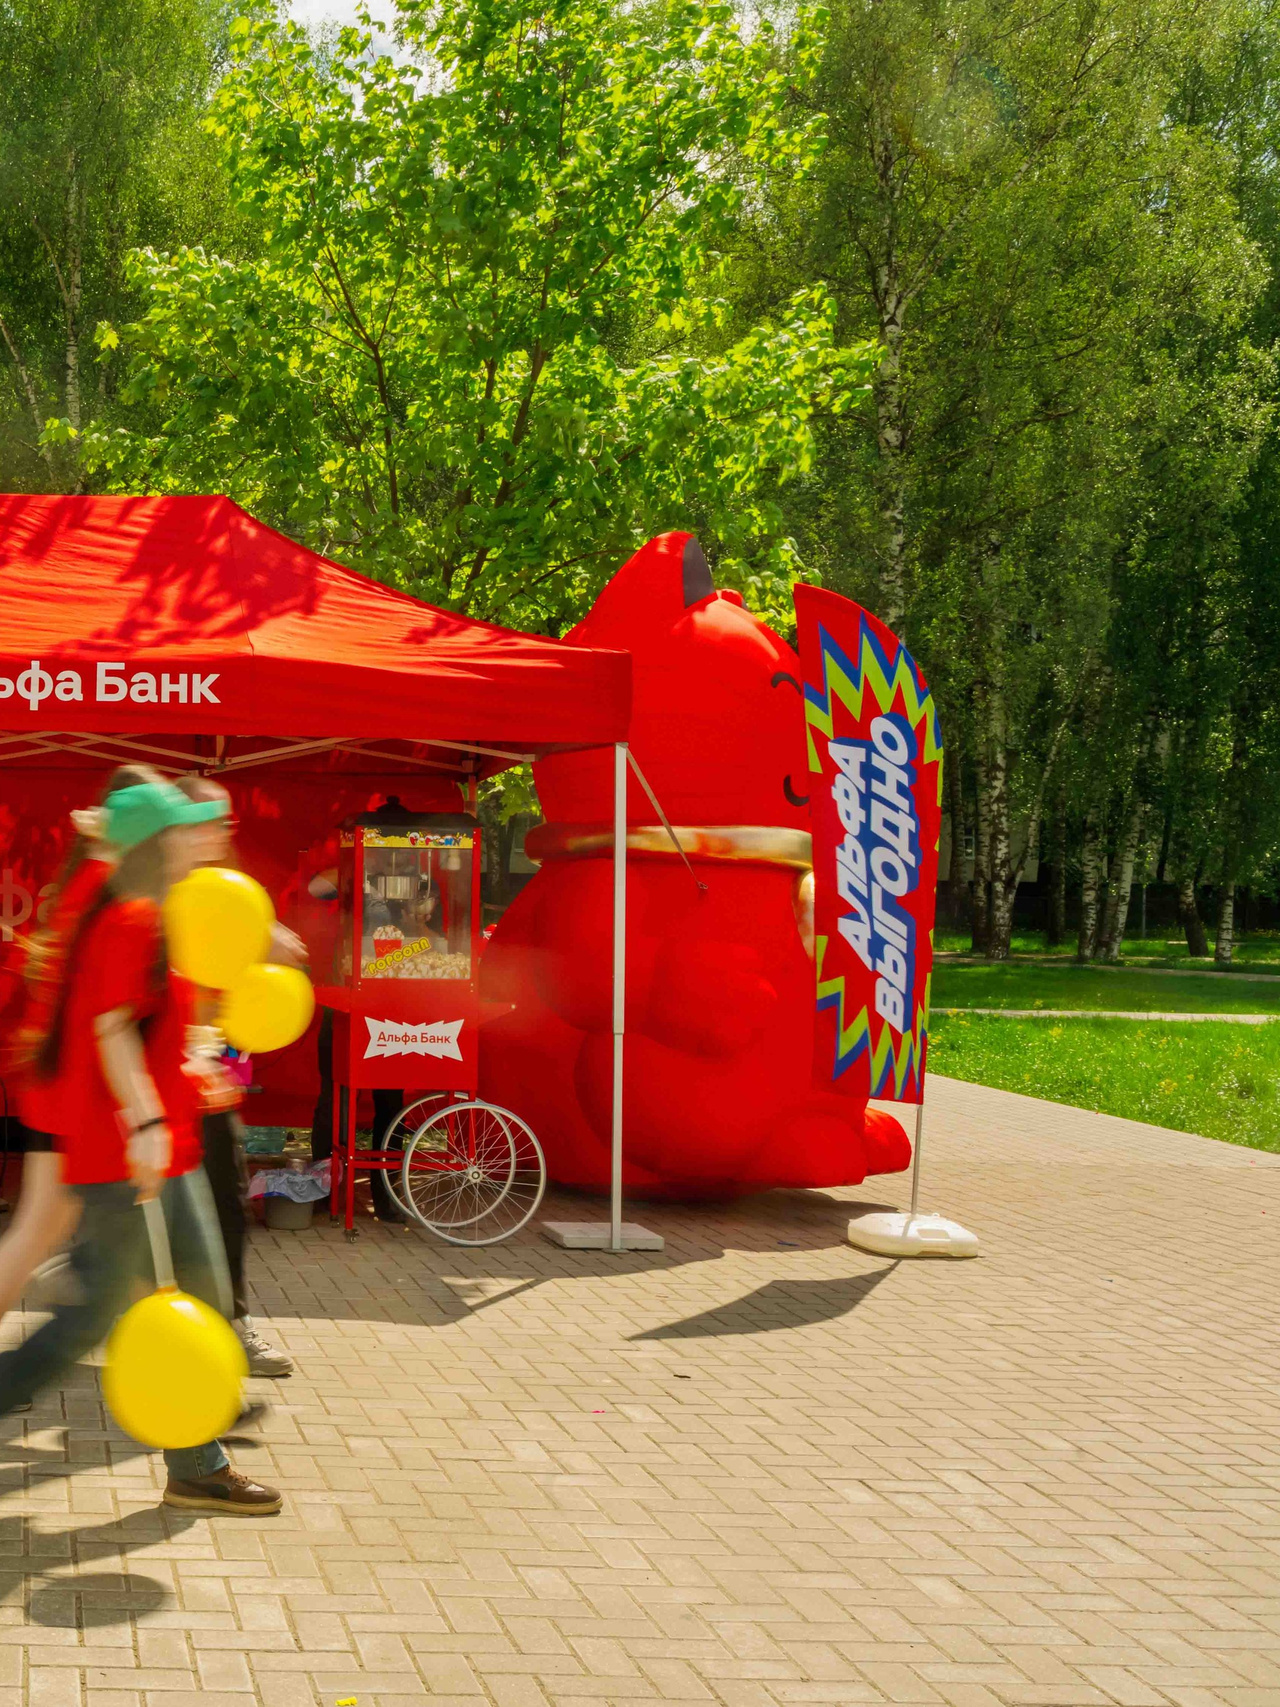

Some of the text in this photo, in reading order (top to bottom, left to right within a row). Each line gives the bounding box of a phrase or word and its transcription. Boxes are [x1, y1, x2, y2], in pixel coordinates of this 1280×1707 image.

[96, 662, 221, 704] Банк
[828, 741, 872, 972] АЛЬФА
[870, 716, 916, 1034] ВЫГОДНО
[377, 1032, 452, 1046] Альфа Банк
